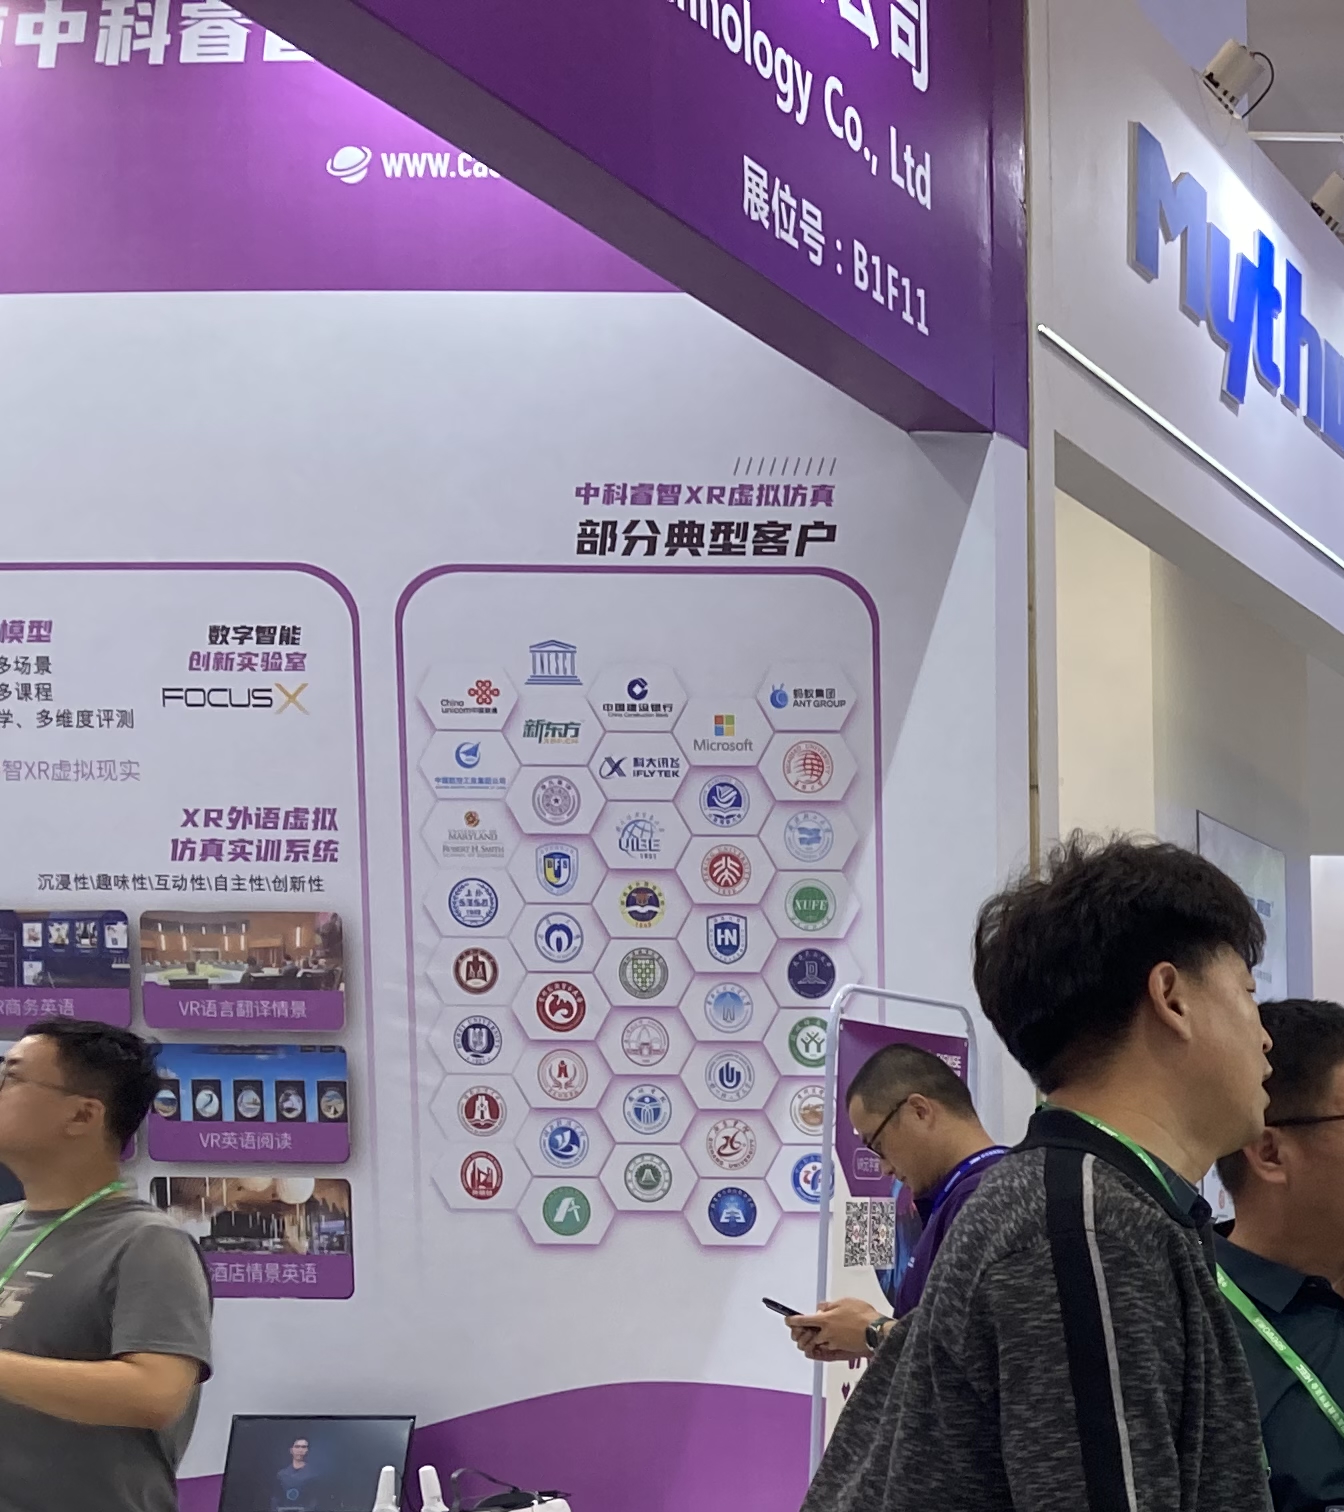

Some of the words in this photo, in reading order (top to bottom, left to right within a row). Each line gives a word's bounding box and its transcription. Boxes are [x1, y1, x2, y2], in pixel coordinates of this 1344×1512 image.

[0, 0, 315, 68] 中科睿
[824, 76, 877, 176] Co.,
[889, 125, 932, 211] Ltd
[575, 483, 834, 507] 中科睿智XR虚拟仿真
[576, 519, 837, 556] 部分典型客户
[208, 625, 302, 646] 数字智能
[188, 651, 308, 672] 创新实验室
[793, 700, 812, 708] ANT
[813, 700, 847, 709] GROUP
[522, 719, 582, 744] 新东方
[692, 739, 754, 752] Microsoft
[632, 756, 681, 768] 科大讯飞
[180, 806, 340, 831] XR外语虚拟
[170, 838, 341, 863] 仿真实训系统
[178, 1000, 308, 1019] VR语言翻译情景
[199, 1132, 293, 1151] VR英语阅读
